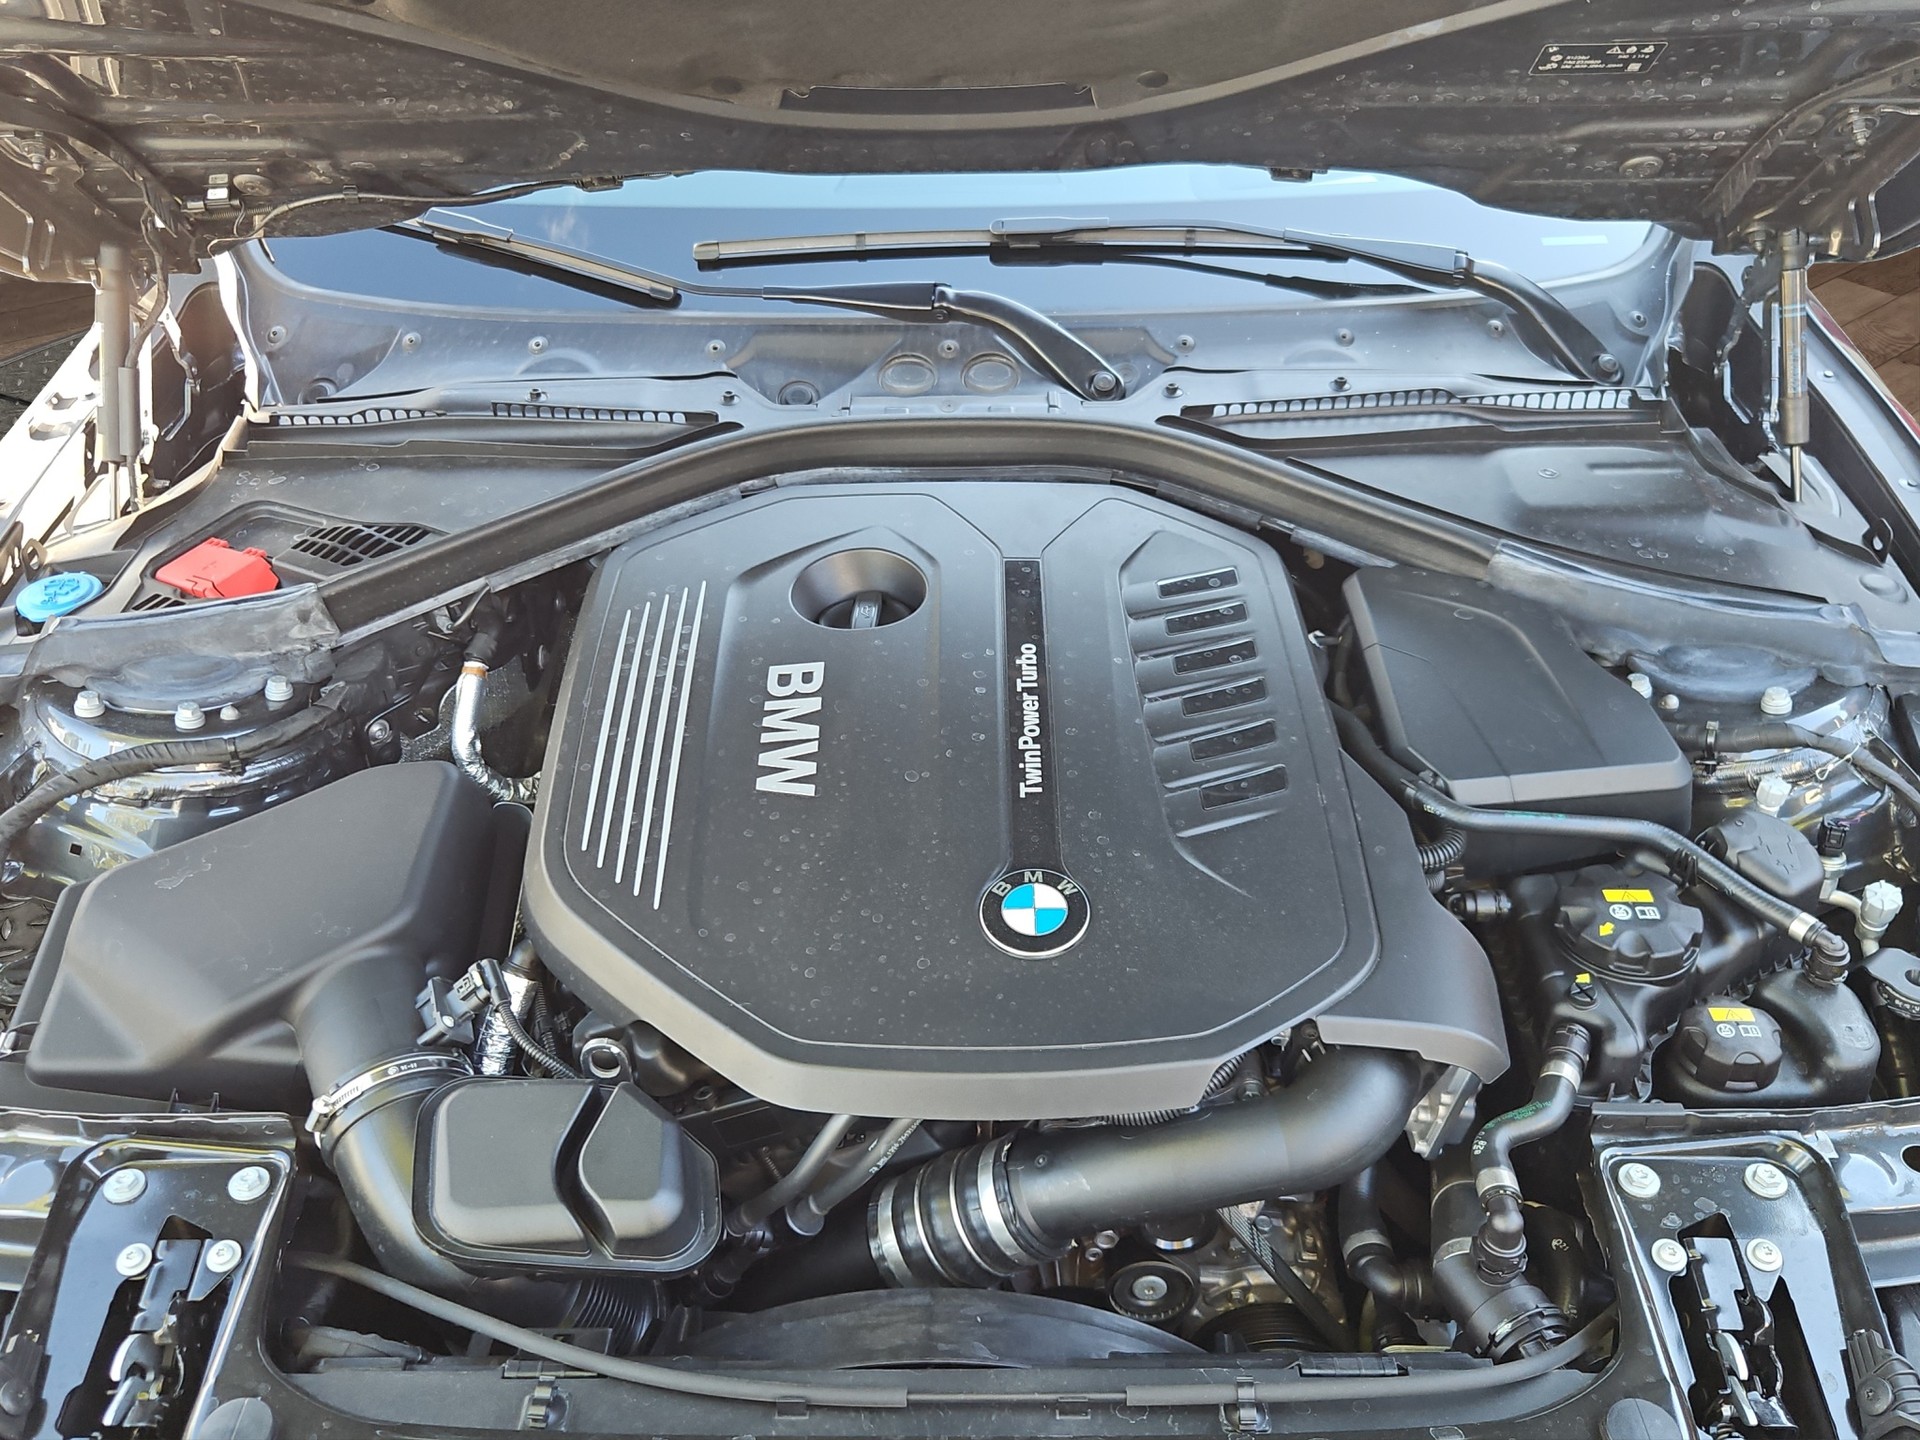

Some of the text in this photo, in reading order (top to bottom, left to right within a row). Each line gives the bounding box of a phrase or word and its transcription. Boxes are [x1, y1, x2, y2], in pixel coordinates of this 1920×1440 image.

[756, 662, 825, 797] BMW
[1016, 643, 1043, 798] TwinPower Turbo
[991, 871, 1079, 897] BMW
